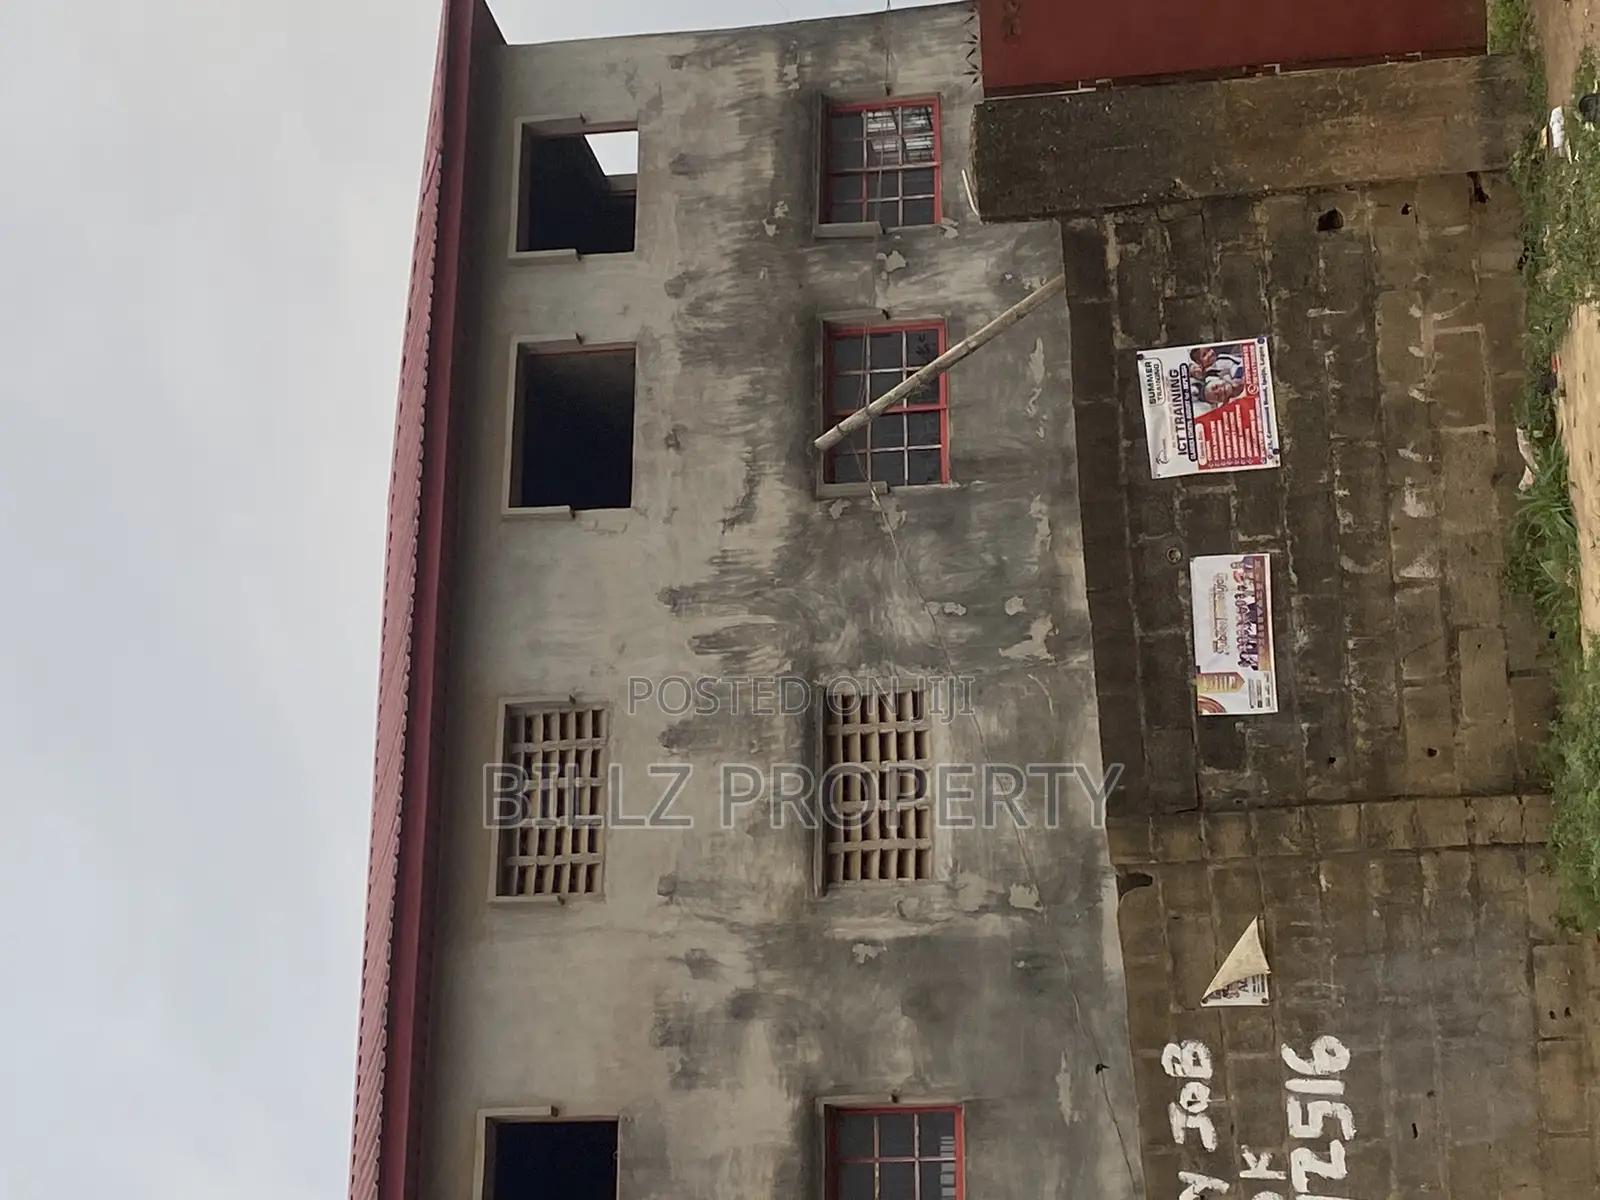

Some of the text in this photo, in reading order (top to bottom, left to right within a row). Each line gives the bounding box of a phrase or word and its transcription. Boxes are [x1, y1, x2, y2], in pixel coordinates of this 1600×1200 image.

[1145, 362, 1156, 404] SUMMER
[1154, 364, 1163, 402] TRAINING
[1170, 368, 1185, 432] TRAINING
[1176, 434, 1188, 456] ICT
[1161, 1040, 1217, 1152] JOB
[1281, 1035, 1356, 1200] 2516
